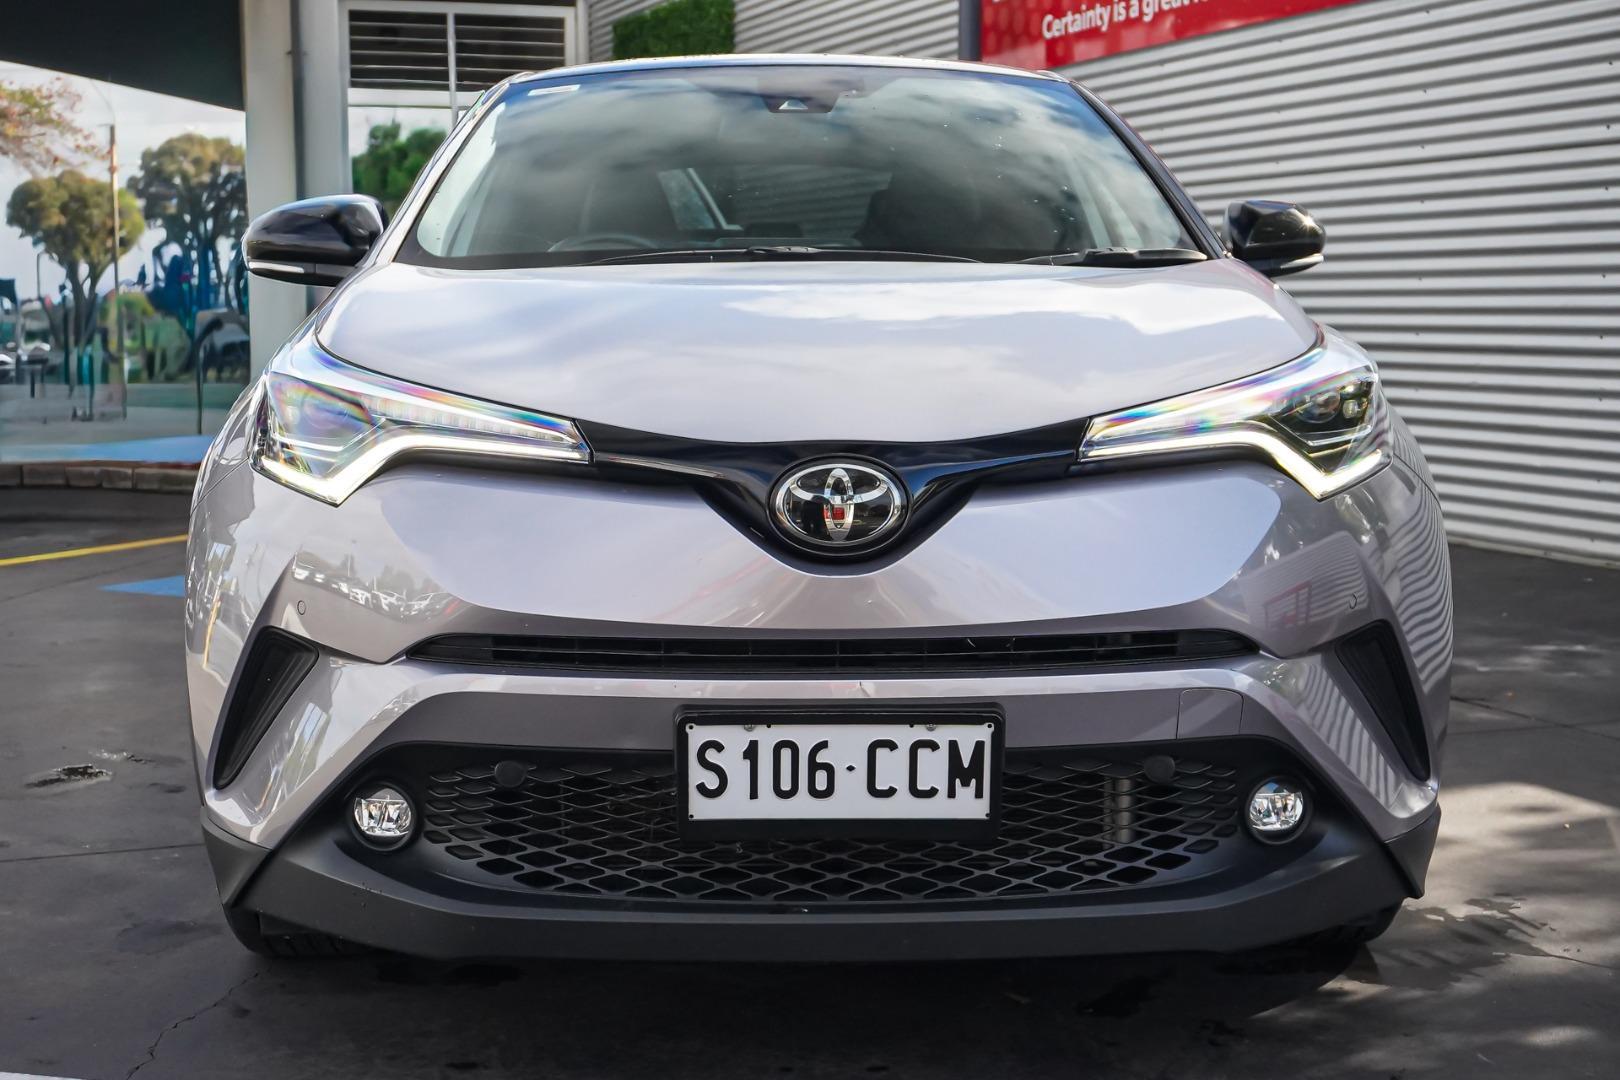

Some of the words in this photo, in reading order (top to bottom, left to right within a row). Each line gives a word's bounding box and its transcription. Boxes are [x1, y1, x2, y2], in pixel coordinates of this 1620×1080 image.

[1042, 4, 1111, 39] Certainty
[1113, 0, 1127, 21] is
[1129, 0, 1140, 18] a
[1142, 0, 1190, 22] gre
